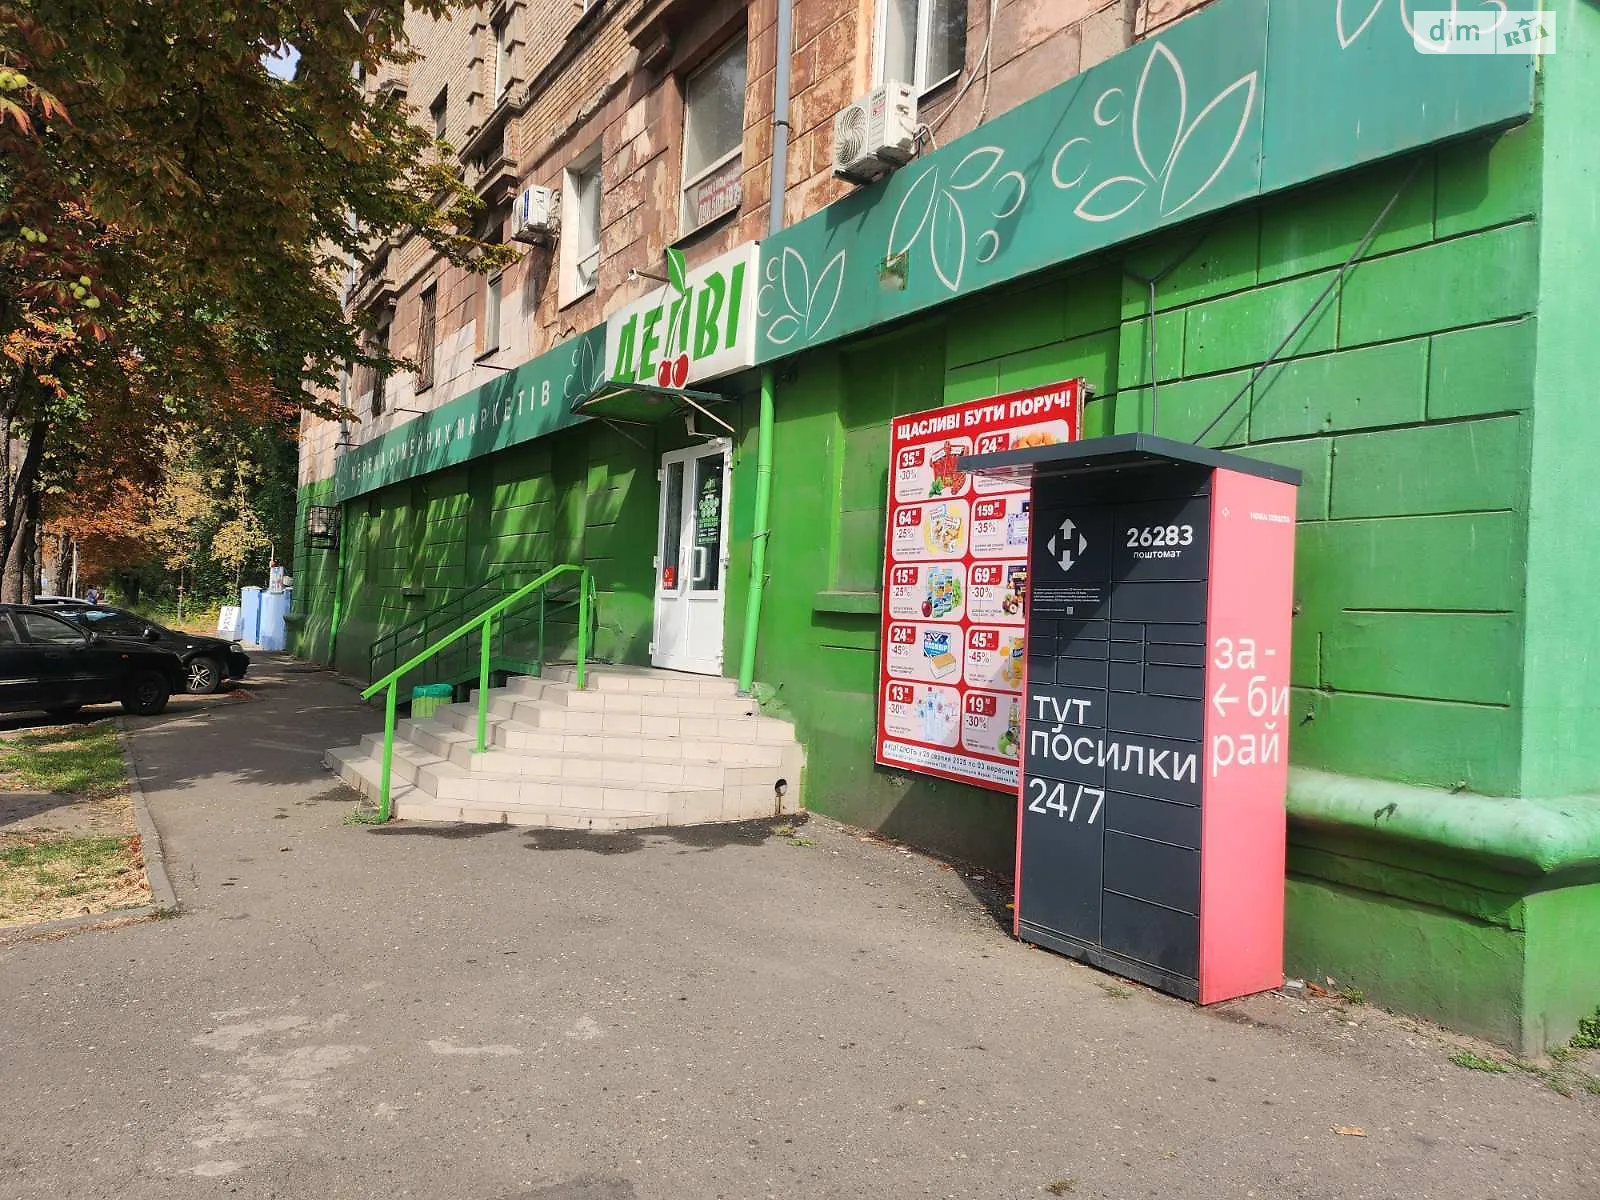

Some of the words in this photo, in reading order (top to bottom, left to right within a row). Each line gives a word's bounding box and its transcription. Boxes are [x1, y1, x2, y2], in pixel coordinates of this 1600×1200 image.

[610, 260, 746, 384] ДЕЛВІ
[457, 380, 551, 441] МАРКЕТІВ
[897, 412, 960, 440] ЩАСЛИВІ
[964, 404, 1005, 428] БУТИ
[1009, 390, 1072, 419] ПОРУЧ!
[981, 437, 997, 454] 24
[902, 452, 915, 467] 35
[898, 510, 912, 525] 64
[977, 504, 994, 517] 159
[1126, 525, 1193, 548] 26283
[1133, 549, 1182, 560] поштомат
[895, 569, 909, 583] 15
[974, 567, 990, 583] 69
[894, 627, 907, 642] 24
[971, 631, 987, 648] 45
[891, 686, 904, 701] 13
[1247, 675, 1290, 717] би
[969, 696, 984, 713] 19
[1032, 695, 1092, 733] тут
[1030, 730, 1197, 784] посилки
[1212, 721, 1280, 777] рай
[1027, 778, 1105, 824] 24/7
